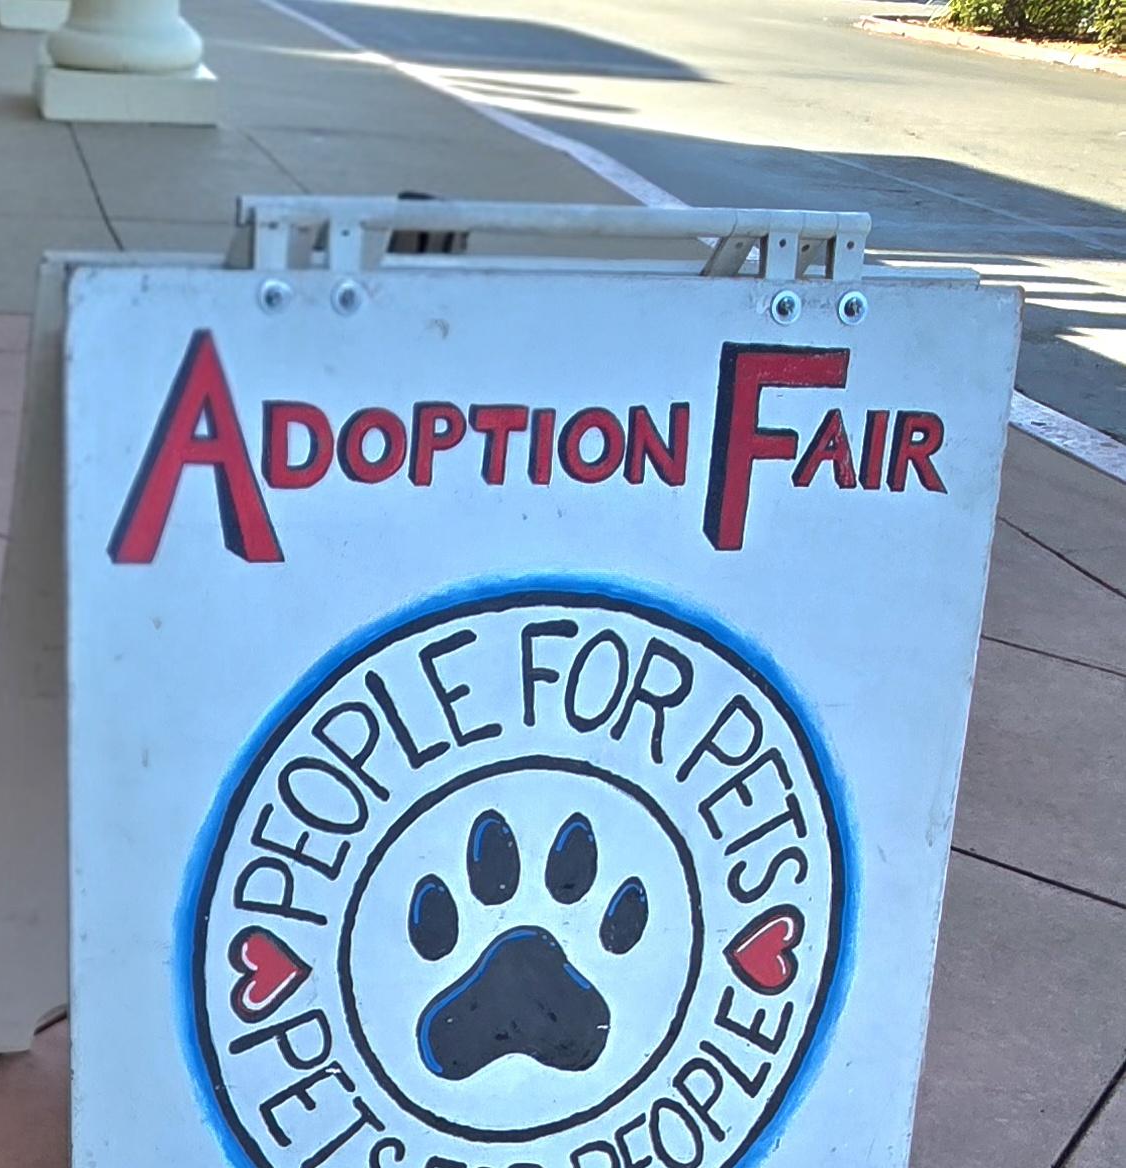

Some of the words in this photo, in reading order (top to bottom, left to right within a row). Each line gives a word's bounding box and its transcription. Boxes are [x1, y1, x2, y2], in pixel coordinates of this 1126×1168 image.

[106, 328, 690, 564] ADOPTION
[703, 341, 948, 552] FAIR
[233, 629, 503, 925] PEOPLE
[520, 619, 694, 764] FOR
[676, 694, 808, 904] PETS
